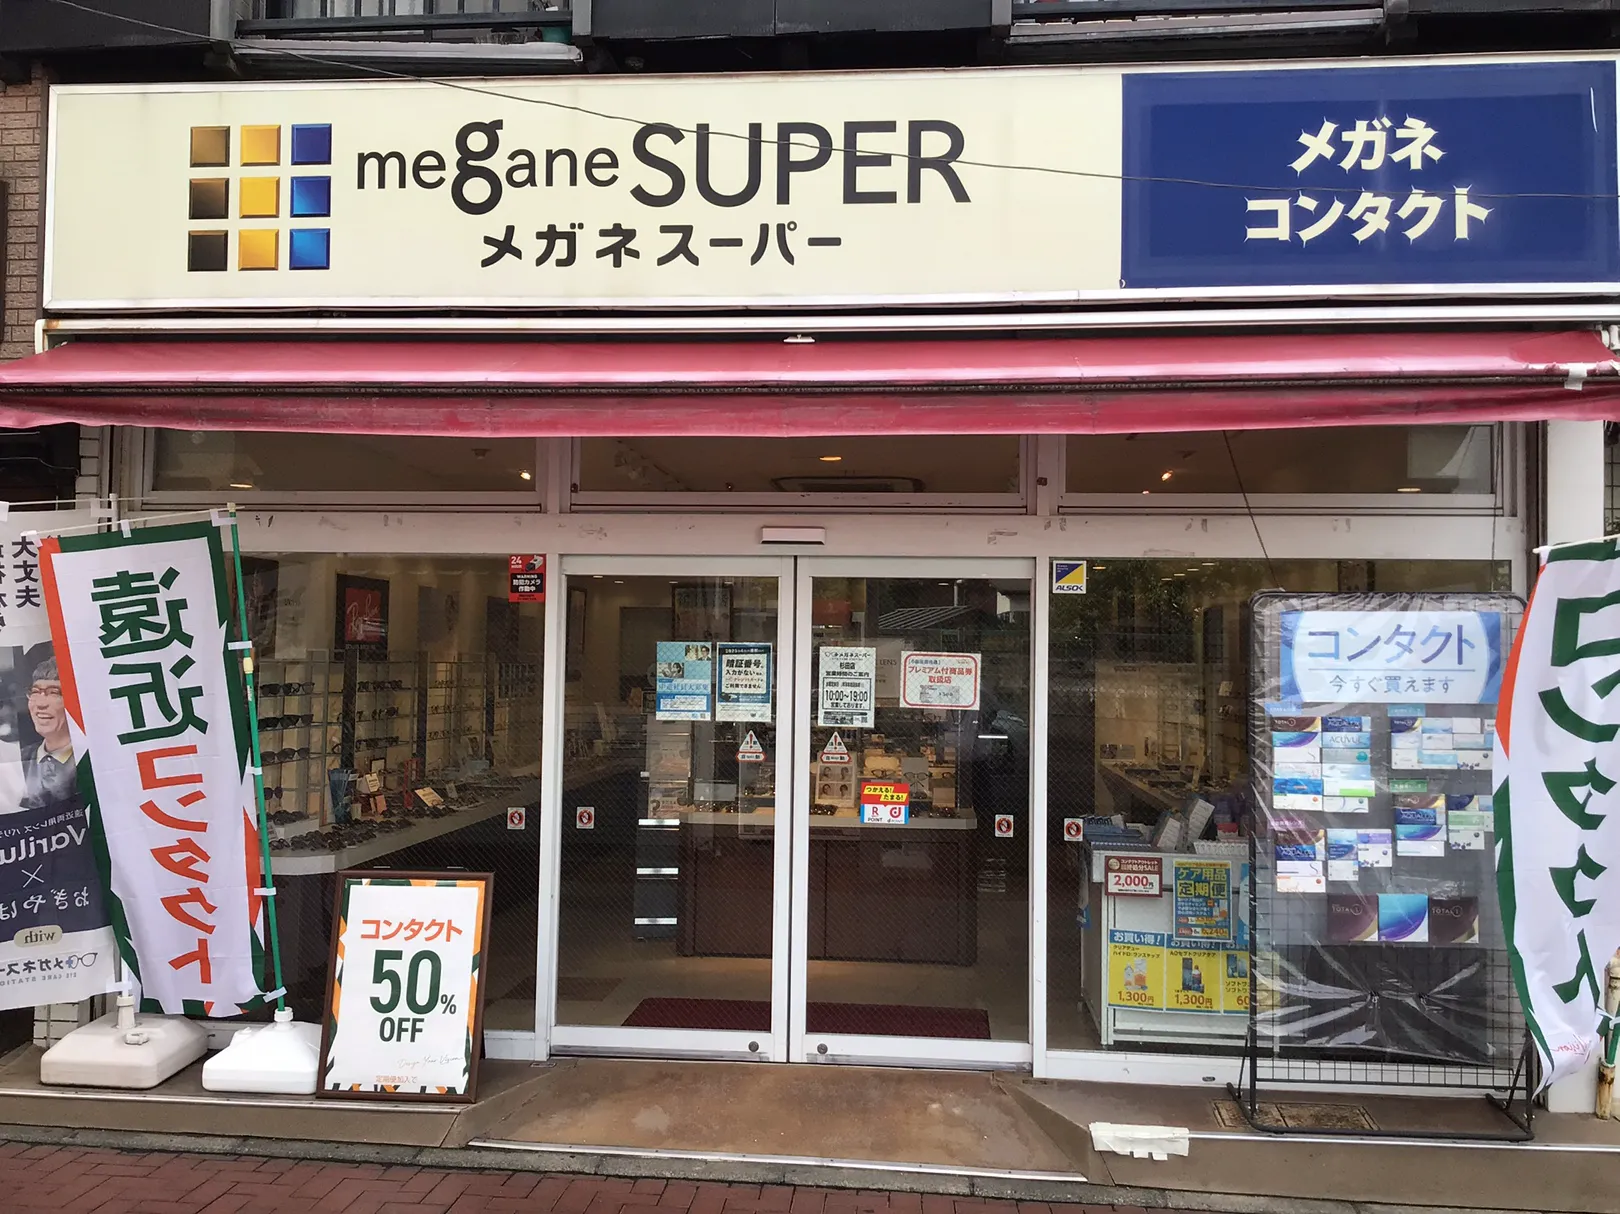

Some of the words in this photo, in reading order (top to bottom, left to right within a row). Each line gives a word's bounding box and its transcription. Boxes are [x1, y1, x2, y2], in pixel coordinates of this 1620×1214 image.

[1290, 115, 1446, 175] メガネ
[1244, 186, 1495, 244] コンタクト
[480, 220, 842, 269] メガネスーパー
[511, 556, 522, 564] 24
[1308, 623, 1475, 665] コンタクト
[1329, 674, 1454, 694] 今すぐ買えます
[1178, 868, 1227, 881] ケア用品
[1178, 881, 1226, 898] 定期便
[361, 918, 463, 942] コンタクト
[1114, 932, 1161, 945] お買い得!
[379, 1017, 424, 1042] OFF
